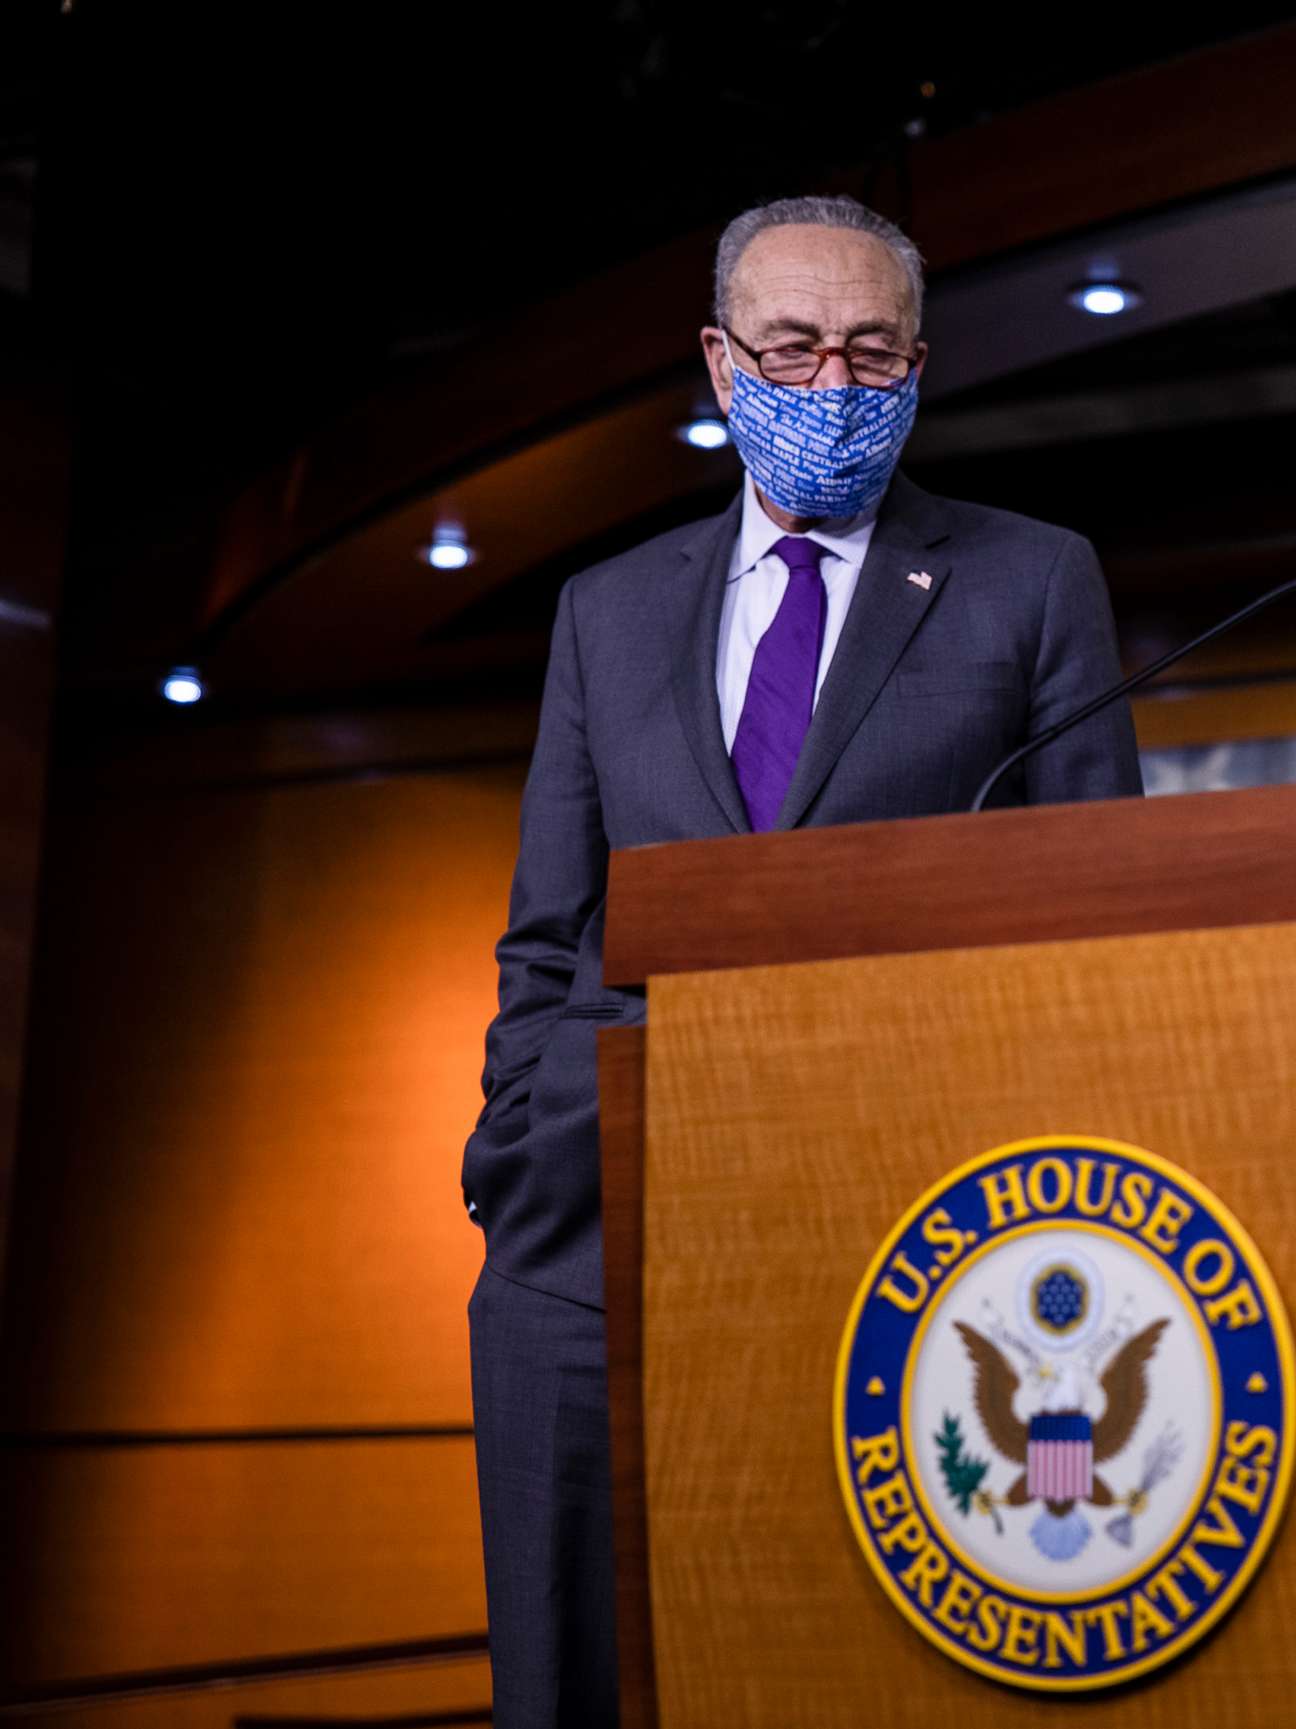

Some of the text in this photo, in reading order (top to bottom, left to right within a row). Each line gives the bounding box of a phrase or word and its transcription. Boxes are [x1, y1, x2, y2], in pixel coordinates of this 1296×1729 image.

[878, 1157, 1262, 1331] U.S. HOUSE OF
[851, 1420, 1278, 1669] REPRESENTATIVES
